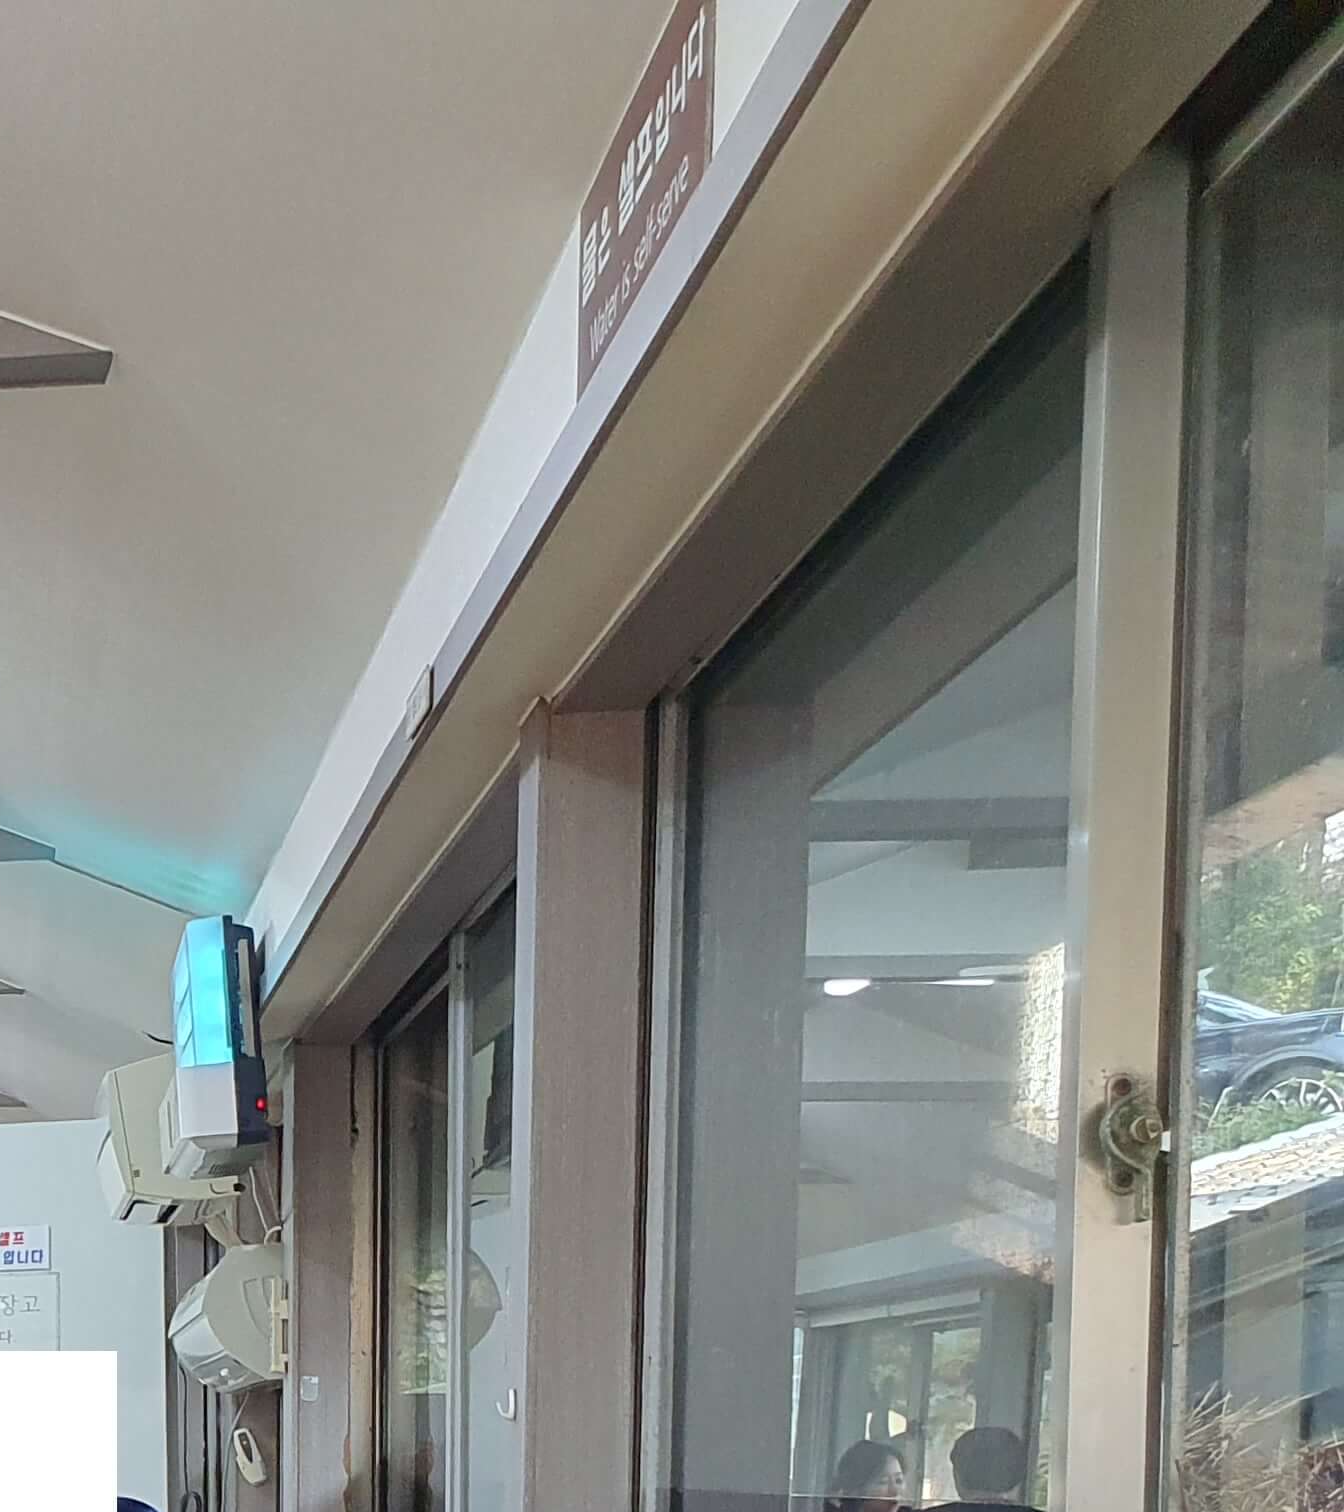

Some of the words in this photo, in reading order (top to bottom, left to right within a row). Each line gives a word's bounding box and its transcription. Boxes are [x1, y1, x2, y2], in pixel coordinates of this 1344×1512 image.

[581, 206, 611, 308] 물은
[617, 6, 705, 236] 셀프입니다
[590, 284, 620, 361] Water
[632, 155, 689, 285] self-serve
[0, 1231, 25, 1247] 셀프
[3, 1249, 44, 1265] 입니다
